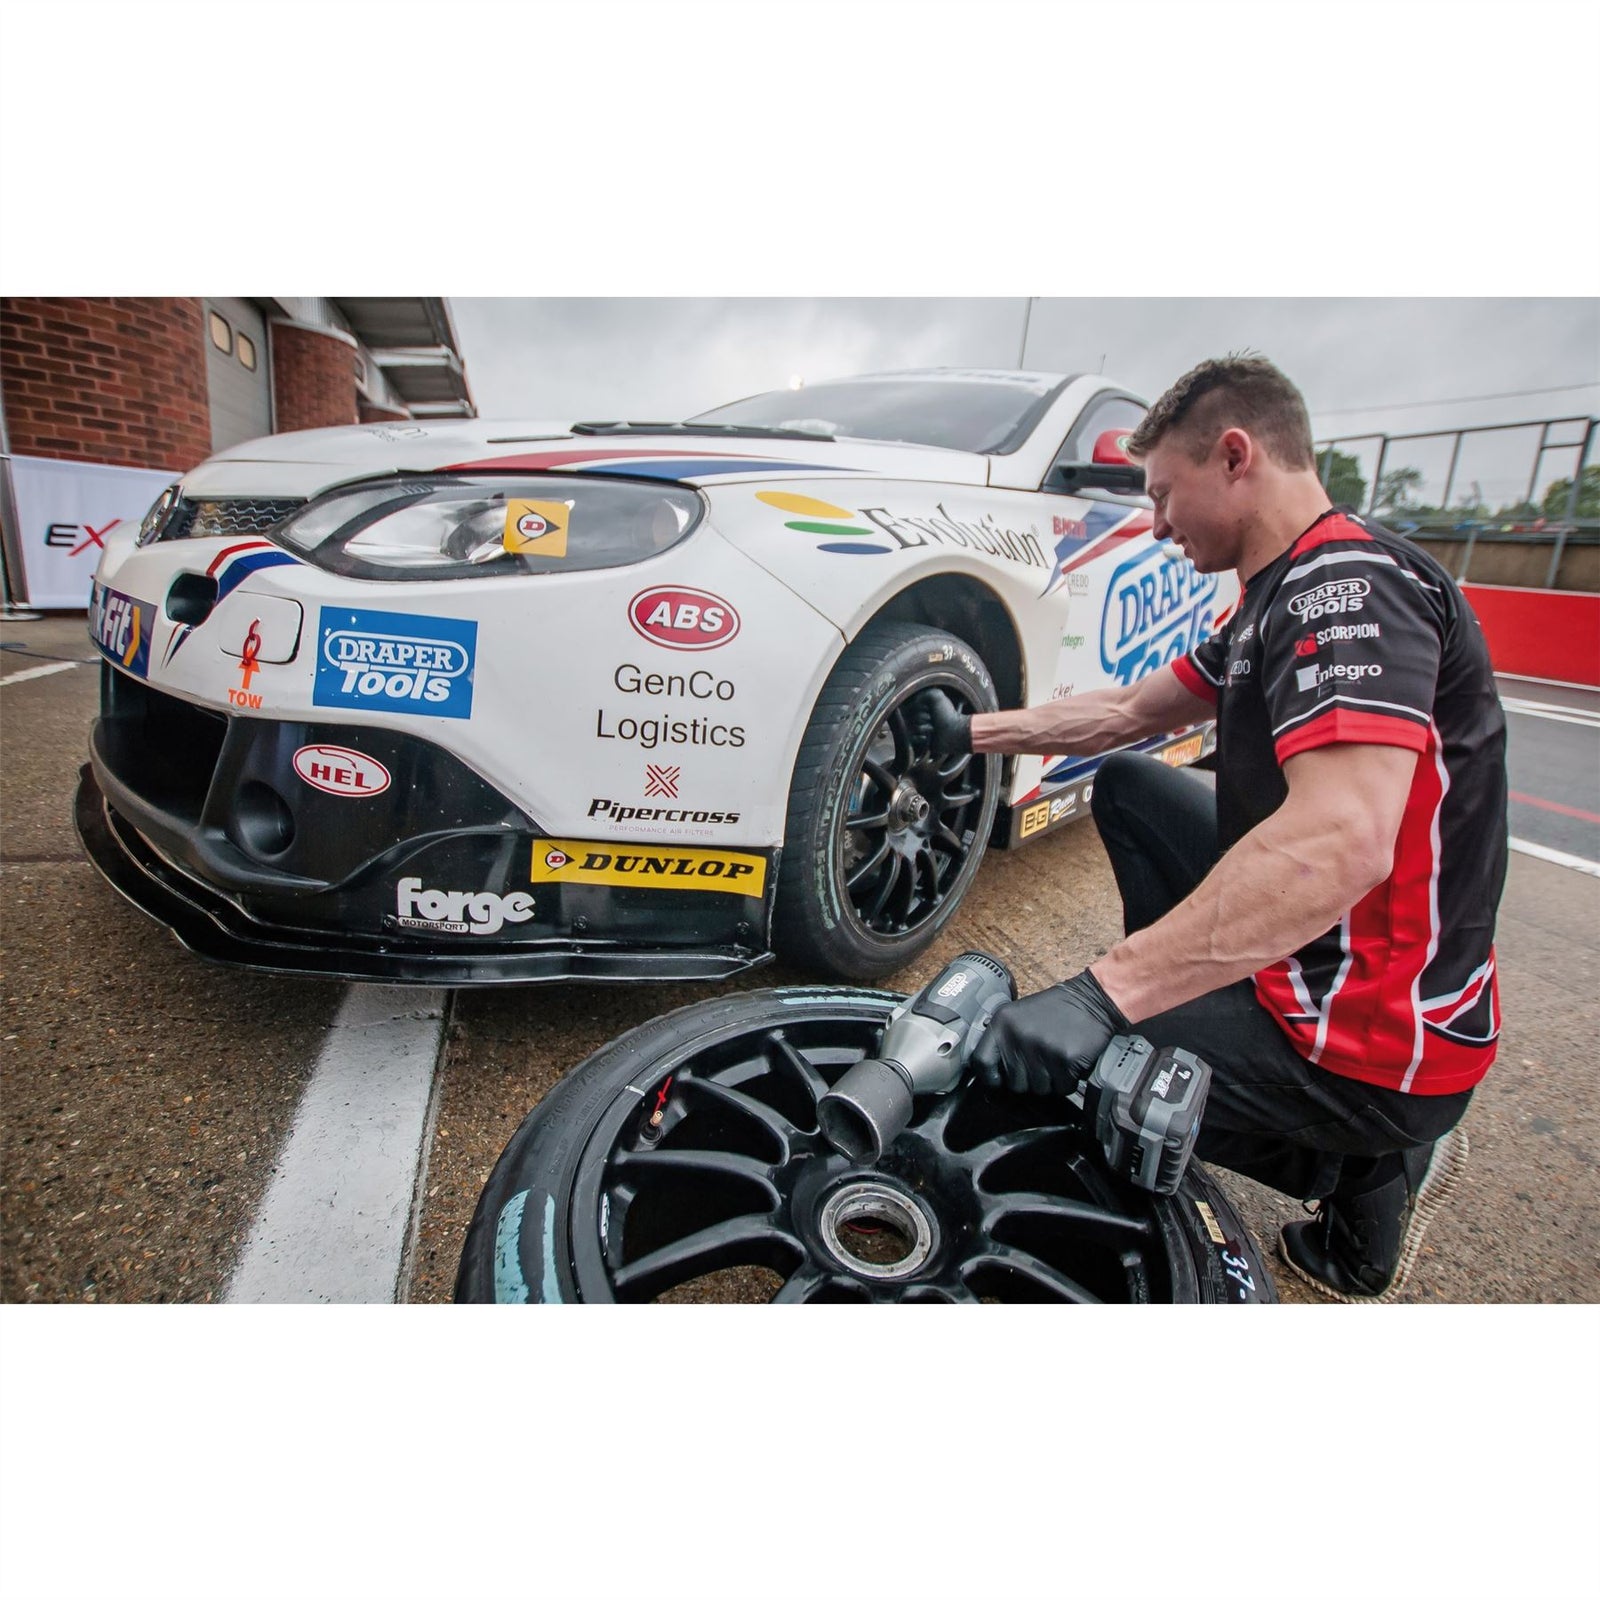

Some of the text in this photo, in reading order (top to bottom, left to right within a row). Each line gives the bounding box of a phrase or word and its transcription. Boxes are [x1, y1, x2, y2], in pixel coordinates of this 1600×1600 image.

[858, 502, 1050, 569] Evolution
[1116, 558, 1214, 651] DRAPE
[1295, 582, 1362, 611] DRAPER
[1299, 596, 1364, 625] Tools
[646, 600, 725, 633] ABS
[1316, 623, 1380, 646] SCORPION
[338, 638, 453, 671] DRAPER
[340, 661, 451, 702] Tools
[614, 664, 735, 701] GenCo
[1315, 664, 1383, 685] integro
[228, 688, 264, 710] TOW
[597, 709, 746, 749] Logistics
[311, 762, 372, 789] HEL
[587, 799, 741, 824] Pipercross
[609, 824, 667, 835] PERFORMANCE
[579, 852, 755, 879] DUNLOP
[397, 877, 537, 935] forge
[402, 919, 465, 931] MOTORSPORT
